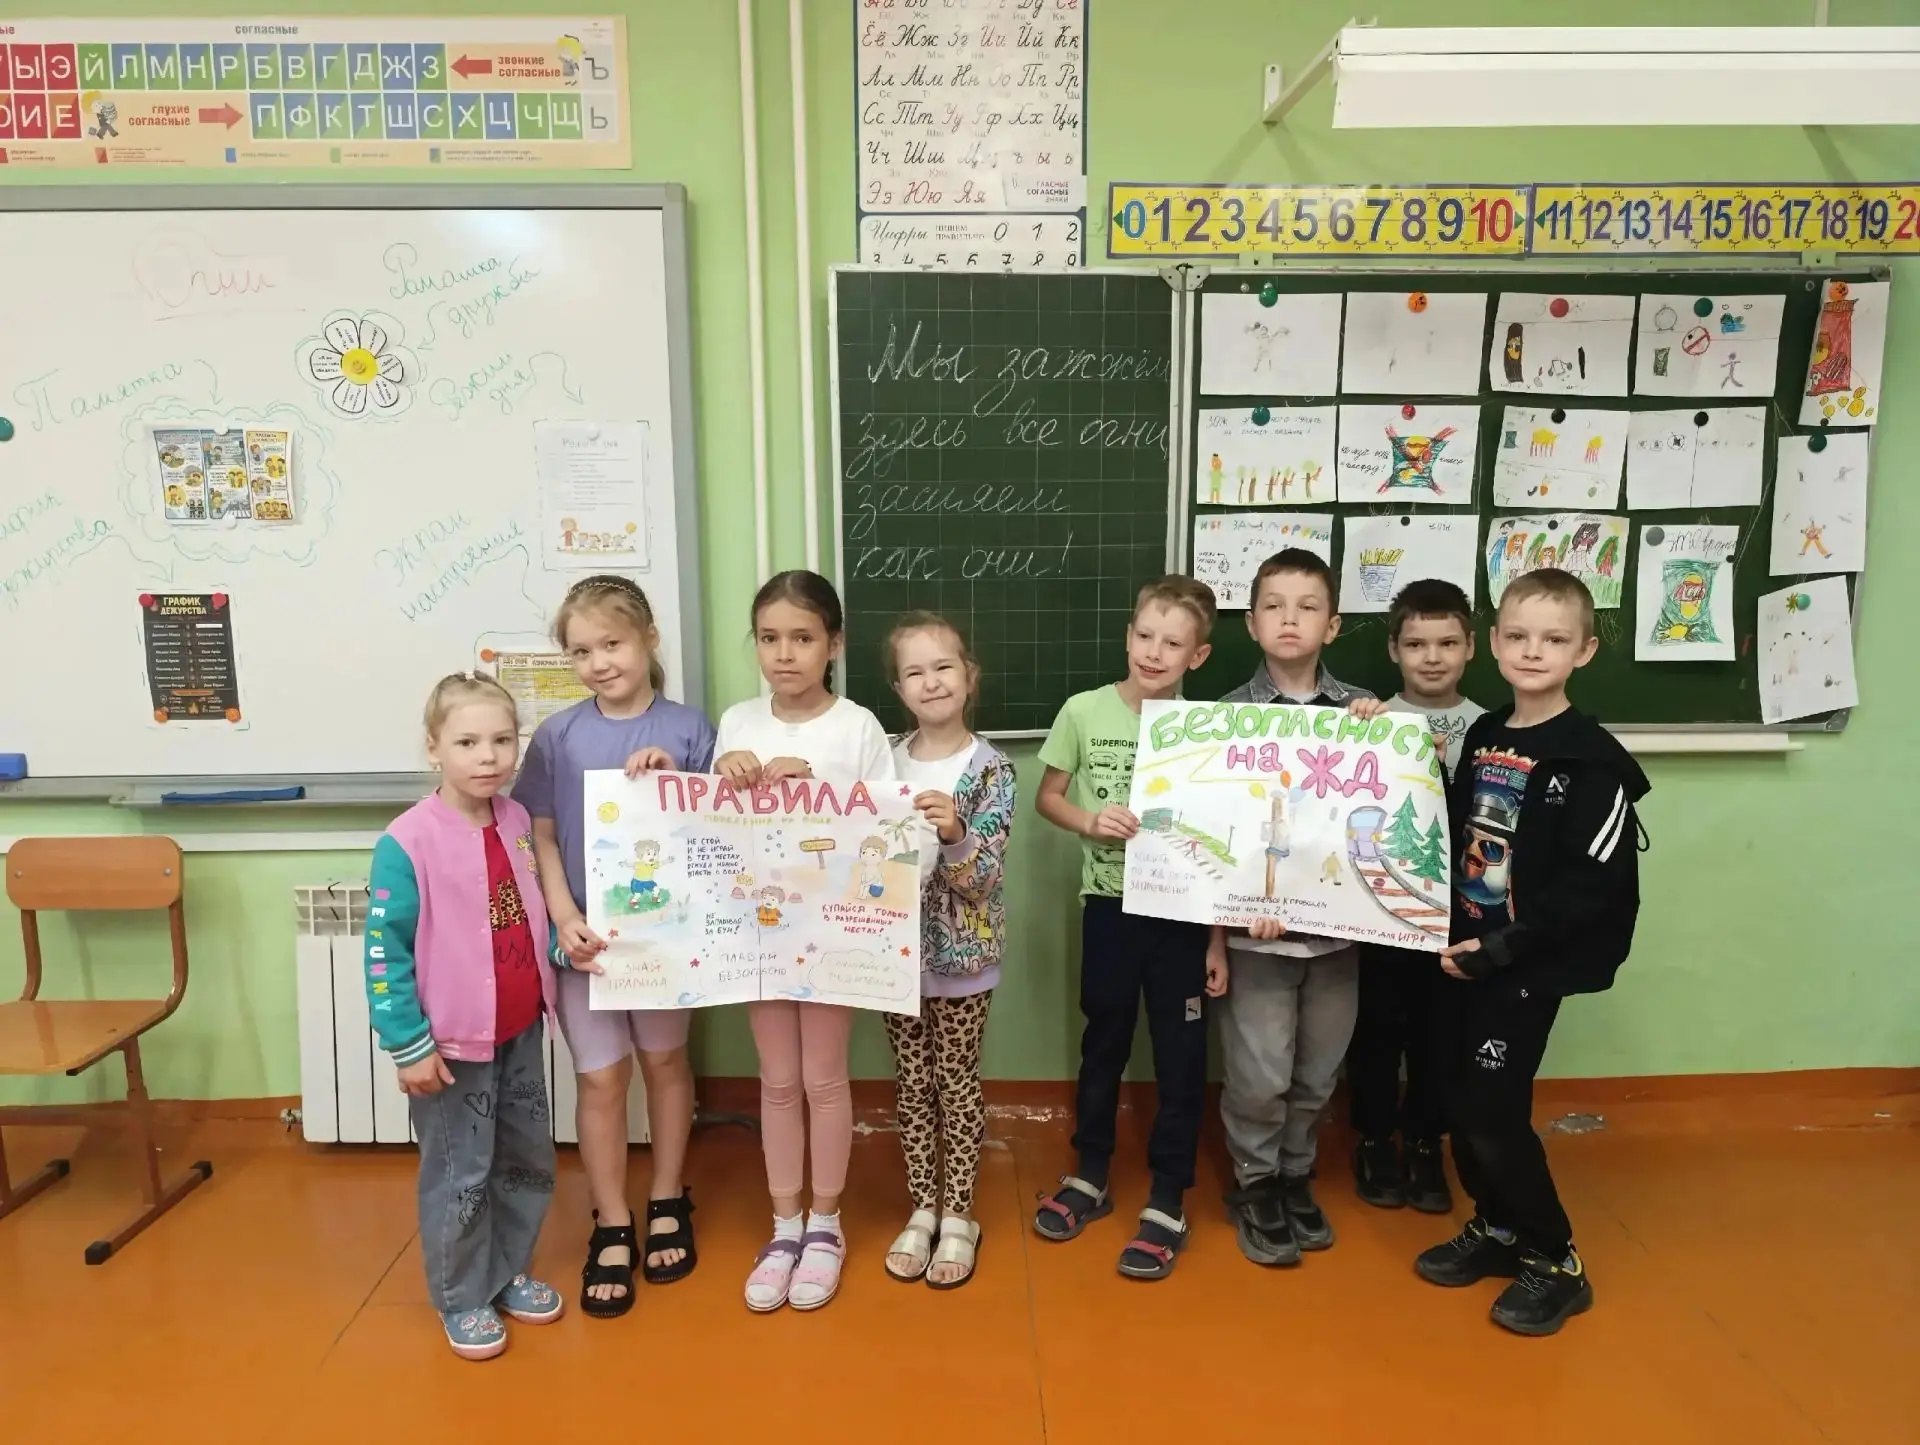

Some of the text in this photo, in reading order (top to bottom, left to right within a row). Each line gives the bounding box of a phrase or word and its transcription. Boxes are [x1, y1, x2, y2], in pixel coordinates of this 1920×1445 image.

[862, 22, 885, 47] Ёё
[892, 24, 939, 47] Жж
[980, 25, 1006, 47] Ии
[1018, 22, 1044, 48] Йй
[1054, 25, 1079, 48] Кк
[16, 53, 439, 80] Ы Э Й Л М Н Р Б В Г Д Ж З
[585, 58, 609, 80] Ъ
[862, 64, 895, 87] Лл
[901, 64, 943, 87] Мм
[950, 64, 980, 87] Нн
[1017, 63, 1047, 87] Пп
[1055, 63, 1079, 94] Рр
[21, 105, 73, 128] И Е
[257, 103, 580, 131] П Ф К Т Ш С Х Ц Ч Щ
[591, 106, 609, 129] Ь
[863, 101, 885, 125] Сс
[892, 101, 934, 125] Тт
[1008, 103, 1044, 125] Хх
[1052, 103, 1079, 130] Цц
[866, 141, 890, 164] Чч
[903, 141, 945, 164] Шш
[866, 180, 986, 204] Ээ Юю Яя
[1123, 197, 1514, 241] 0 1 2 3 4 5 6 7 8 9 10
[1545, 199, 1888, 240] 11 12 13 14 15 16 17 18 19
[994, 222, 1079, 243] 0 1 2
[868, 320, 979, 384] Мы
[1003, 398, 1064, 447] все
[852, 546, 942, 580] как
[160, 606, 208, 616] ДЕЖУРСТВА
[163, 596, 201, 607] ГРАФИК
[1296, 745, 1389, 800] ЖД
[658, 775, 878, 816] ПРАВИЛА
[687, 836, 721, 845] НЕ СТОЙ
[687, 846, 693, 854] И
[710, 844, 734, 853] ИГРАЙ
[705, 911, 717, 920] НЕ
[822, 901, 909, 921] КУПАЙСЯ ТОЛЬКО
[1273, 906, 1281, 916] 2
